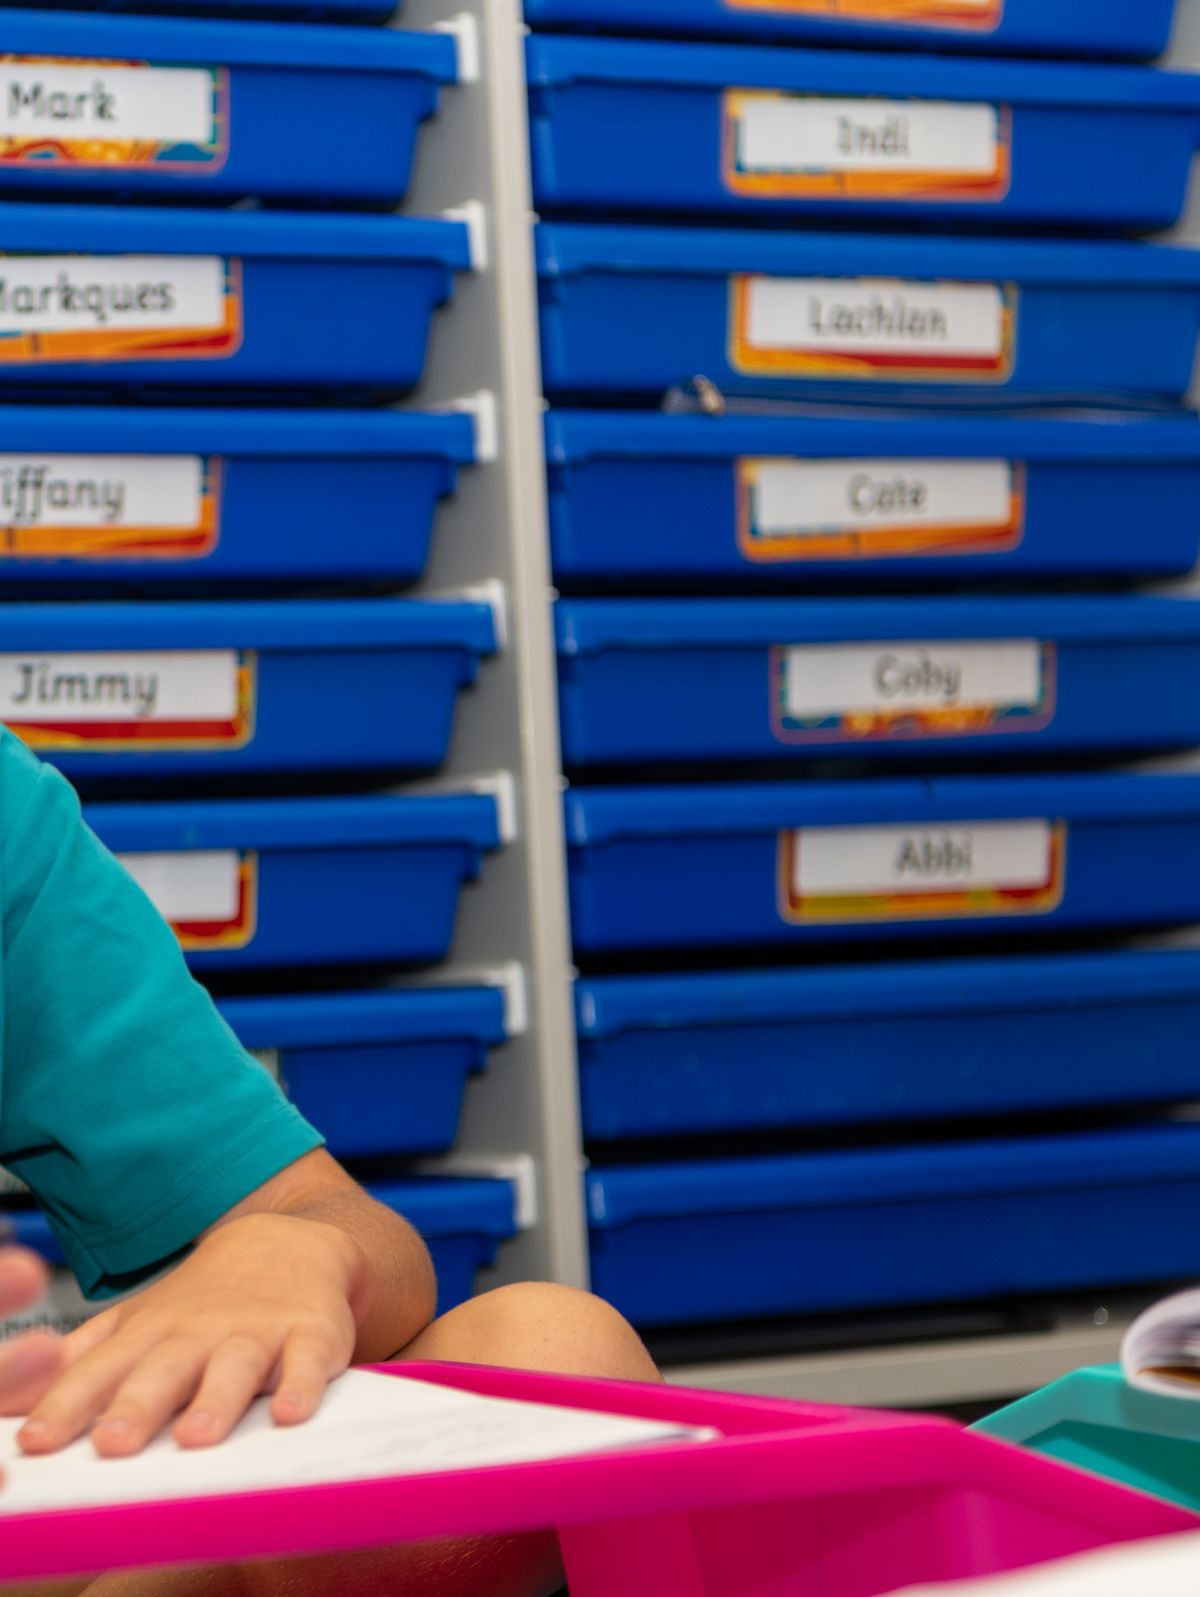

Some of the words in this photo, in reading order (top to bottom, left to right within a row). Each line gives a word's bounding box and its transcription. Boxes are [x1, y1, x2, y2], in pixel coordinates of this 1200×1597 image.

[8, 82, 117, 122] Mark
[837, 114, 910, 157] Indi
[809, 295, 947, 341] Lachlan
[847, 472, 928, 515] Cate
[12, 662, 158, 717] Jimmy
[873, 647, 961, 704] Coby
[896, 832, 973, 877] Abbi
